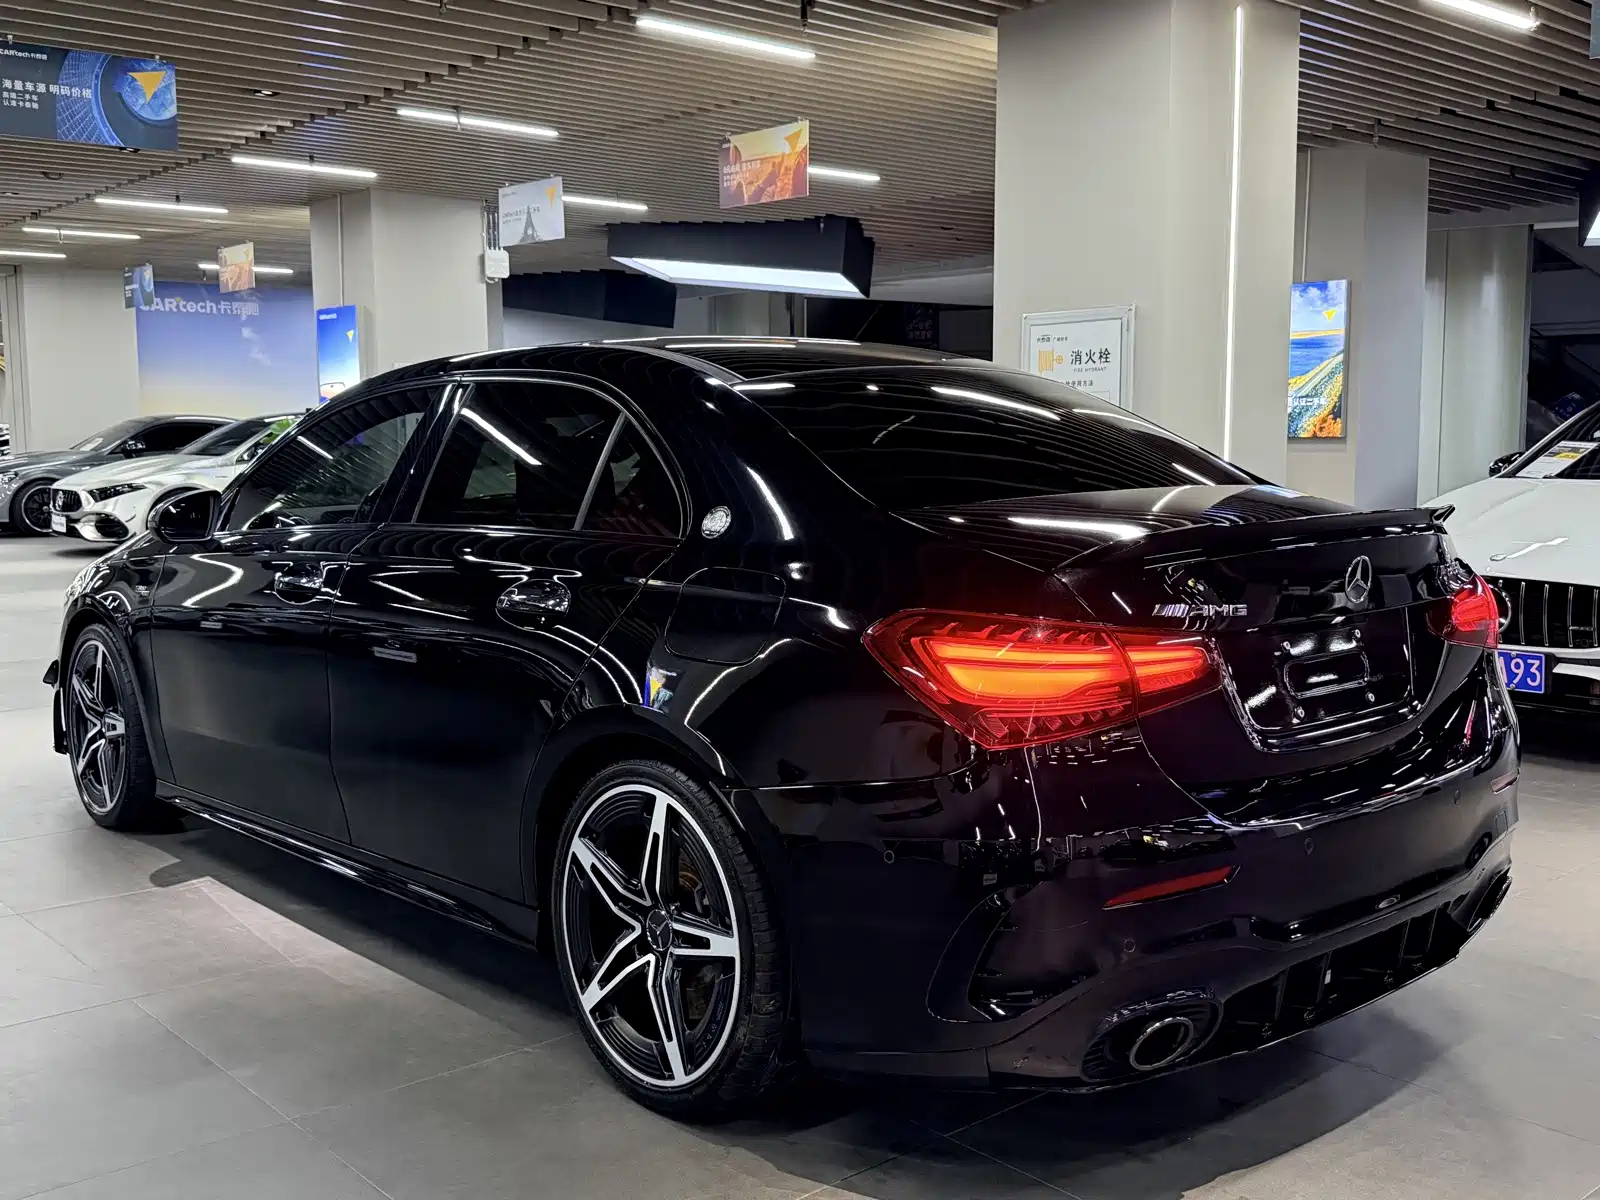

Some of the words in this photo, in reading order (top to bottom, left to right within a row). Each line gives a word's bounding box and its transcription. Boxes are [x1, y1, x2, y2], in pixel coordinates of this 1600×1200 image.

[2, 78, 47, 93] 海量车源
[49, 84, 92, 99] 明码价格
[140, 297, 217, 314] ARtech
[1070, 347, 1111, 366] 消火栓
[1189, 604, 1248, 617] AMG
